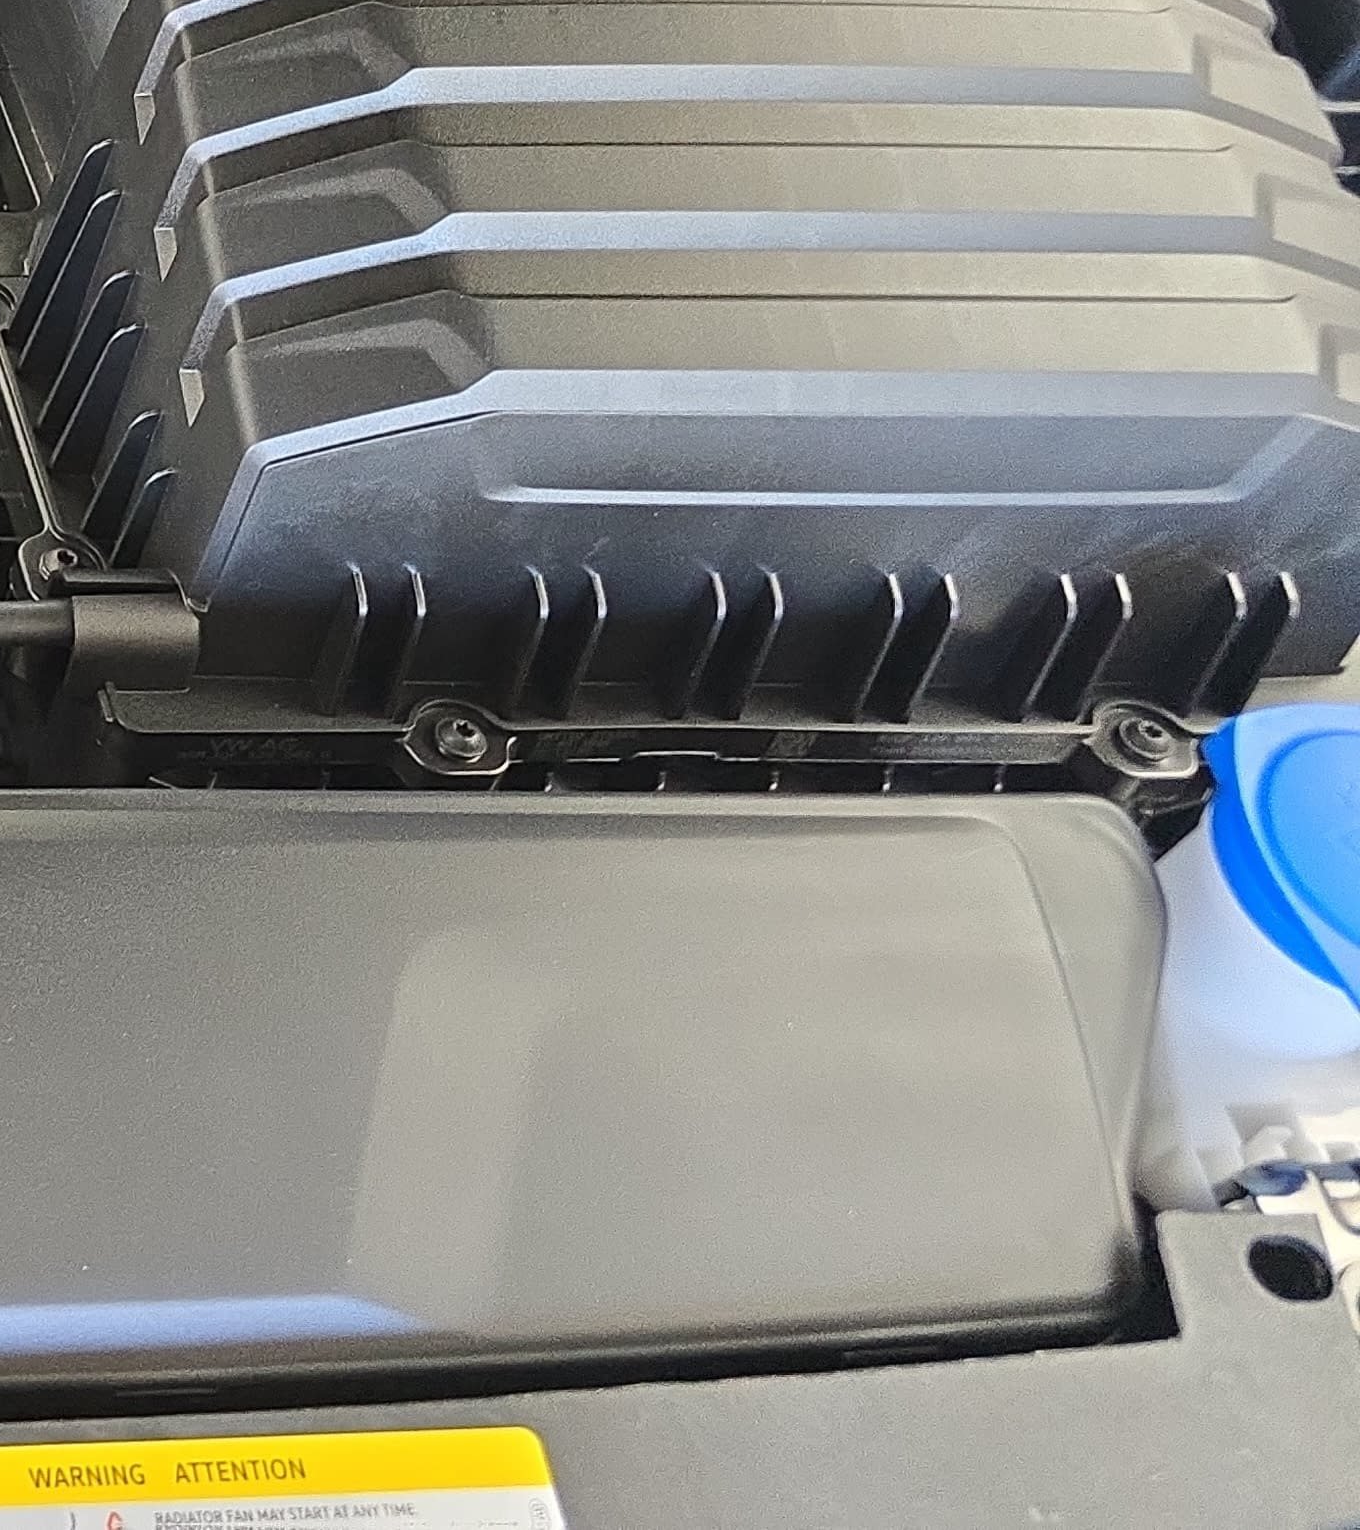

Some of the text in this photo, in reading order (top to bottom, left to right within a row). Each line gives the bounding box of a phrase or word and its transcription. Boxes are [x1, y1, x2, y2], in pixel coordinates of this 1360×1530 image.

[29, 1458, 307, 1488] WARNING ATTENTION
[154, 1510, 224, 1524] RADIATOR
[226, 1509, 254, 1523] FAN
[257, 1508, 285, 1521] MAY
[289, 1506, 330, 1520] START
[333, 1505, 349, 1518] AT
[352, 1504, 379, 1517] ANY
